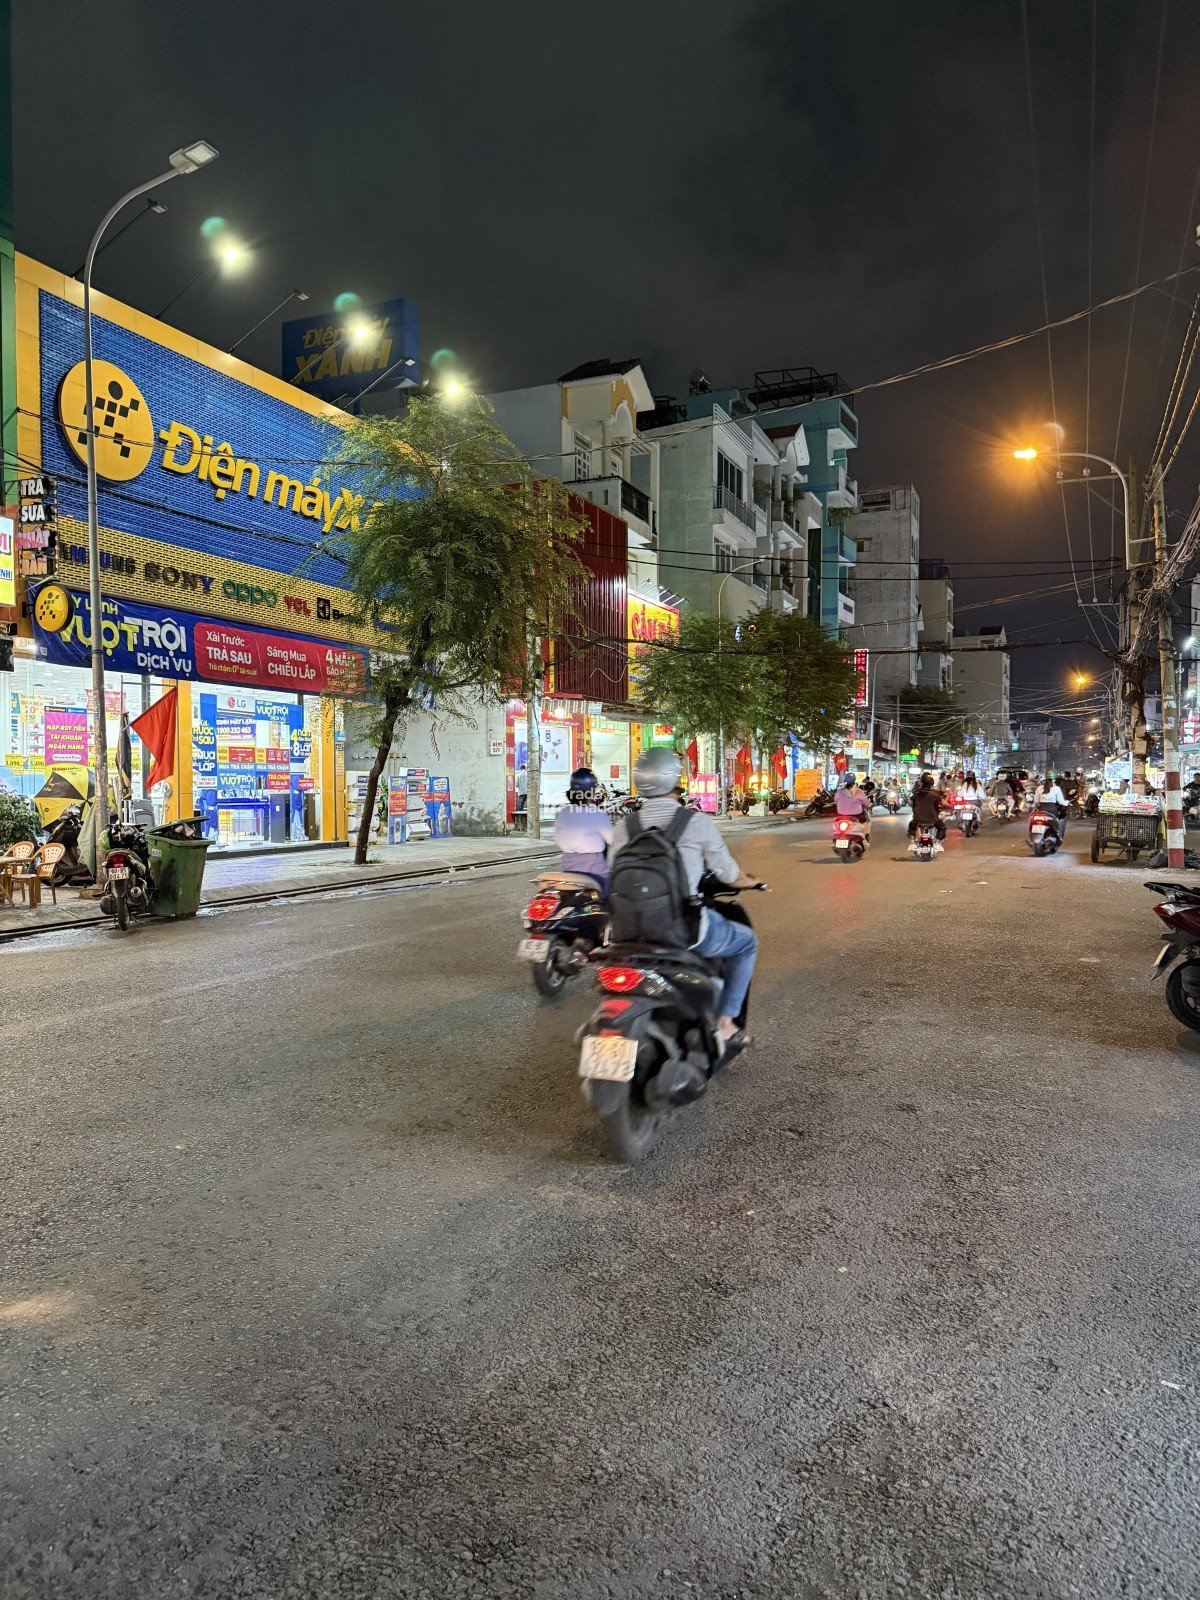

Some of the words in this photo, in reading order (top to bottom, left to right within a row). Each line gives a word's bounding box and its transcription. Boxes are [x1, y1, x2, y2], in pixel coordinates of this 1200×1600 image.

[296, 339, 392, 384] XANH
[159, 421, 260, 499] Điện
[264, 477, 343, 534] máy
[144, 562, 215, 593] SONY
[124, 617, 187, 657] TRỘI
[206, 631, 220, 643] Xài
[222, 633, 246, 647] Trước
[230, 651, 252, 665] SAU
[267, 646, 289, 662] Sáng
[289, 652, 307, 663] Mua
[173, 658, 192, 677] VỤ
[236, 699, 246, 708] LG
